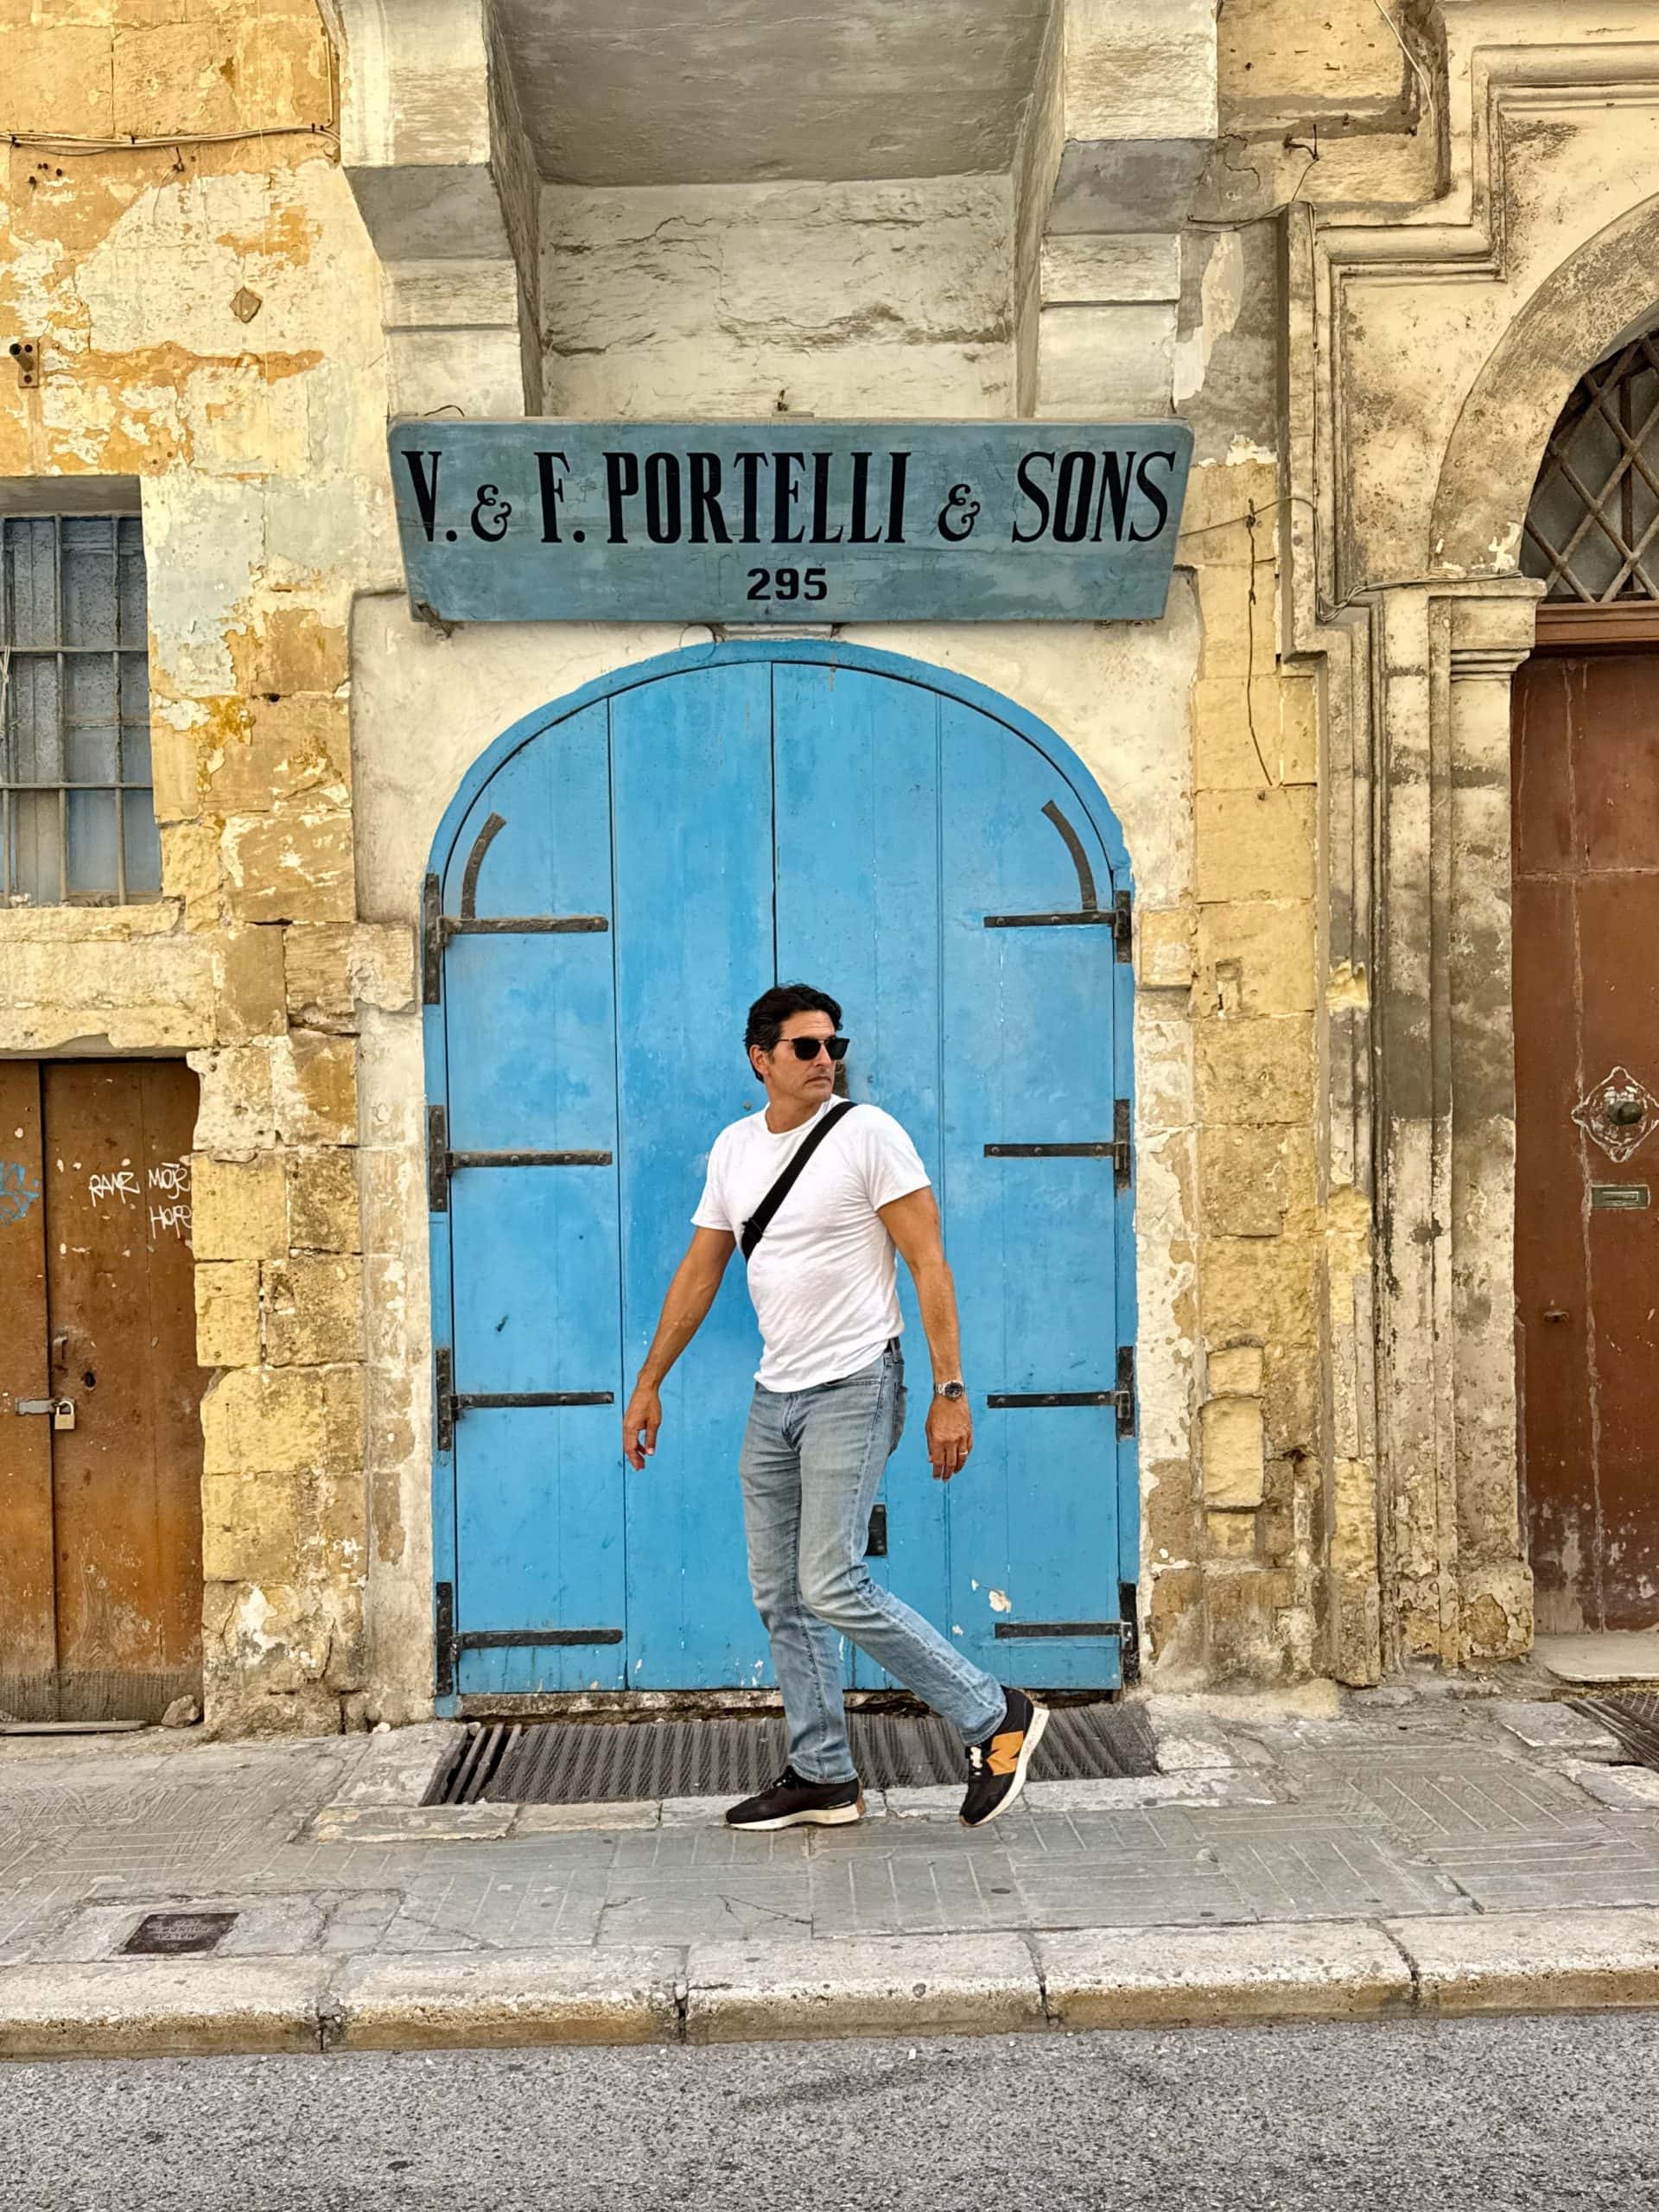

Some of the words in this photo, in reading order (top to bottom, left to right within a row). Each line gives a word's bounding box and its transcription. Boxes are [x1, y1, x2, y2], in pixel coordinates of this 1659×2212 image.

[400, 450, 458, 543] V.
[470, 484, 512, 543] &
[533, 452, 586, 543] F.
[601, 451, 912, 543] PORTELLI
[937, 483, 981, 543] &
[1011, 450, 1176, 543] SONS
[747, 567, 828, 601] 295
